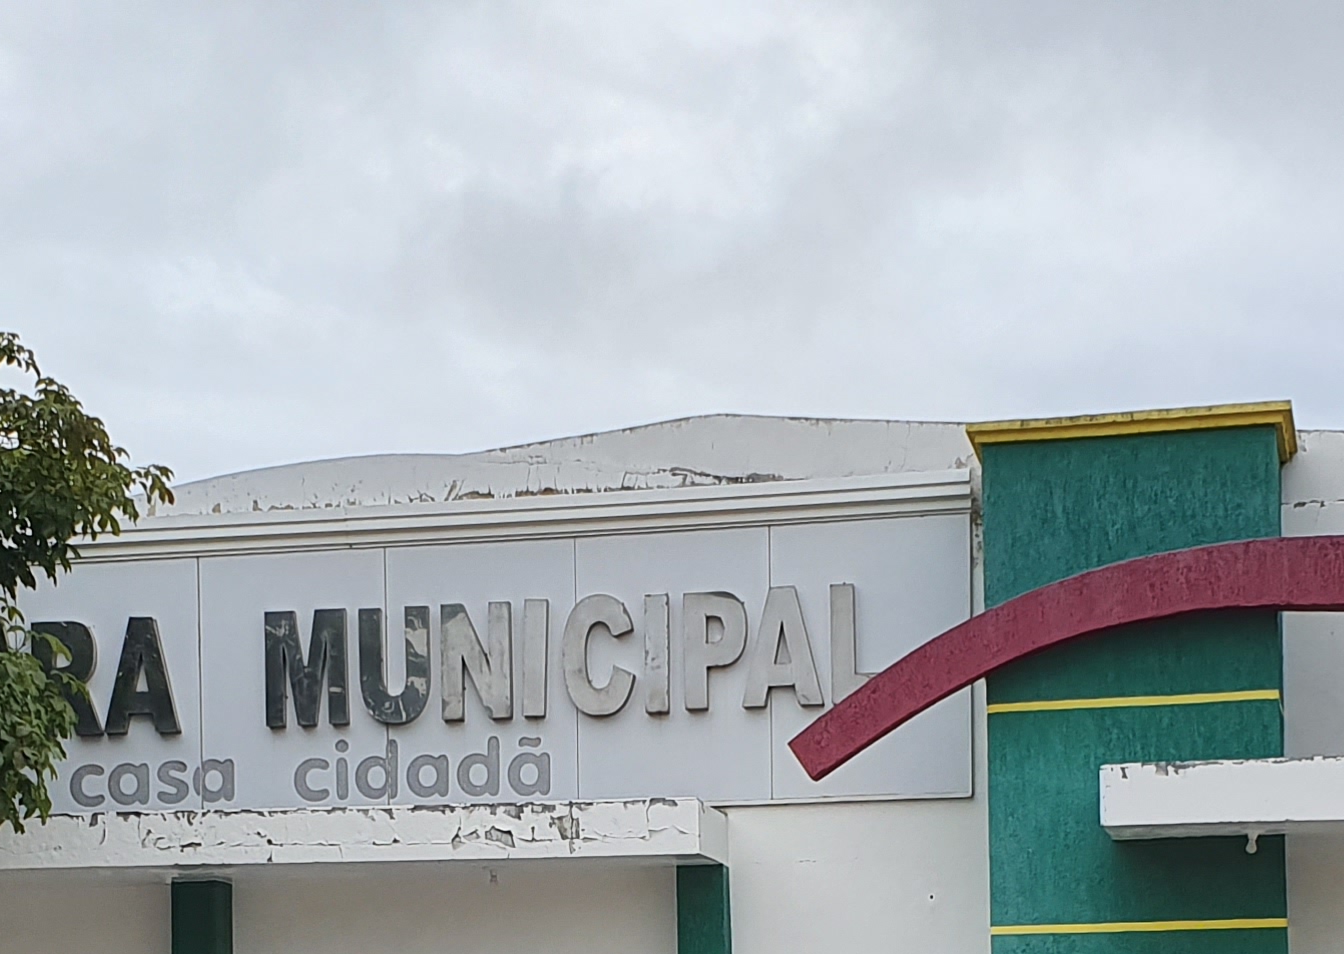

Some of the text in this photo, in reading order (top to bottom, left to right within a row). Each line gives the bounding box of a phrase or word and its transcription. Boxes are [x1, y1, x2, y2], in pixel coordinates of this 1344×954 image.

[263, 582, 882, 728] MUNICIPAL
[69, 735, 551, 808] casa cidadã
